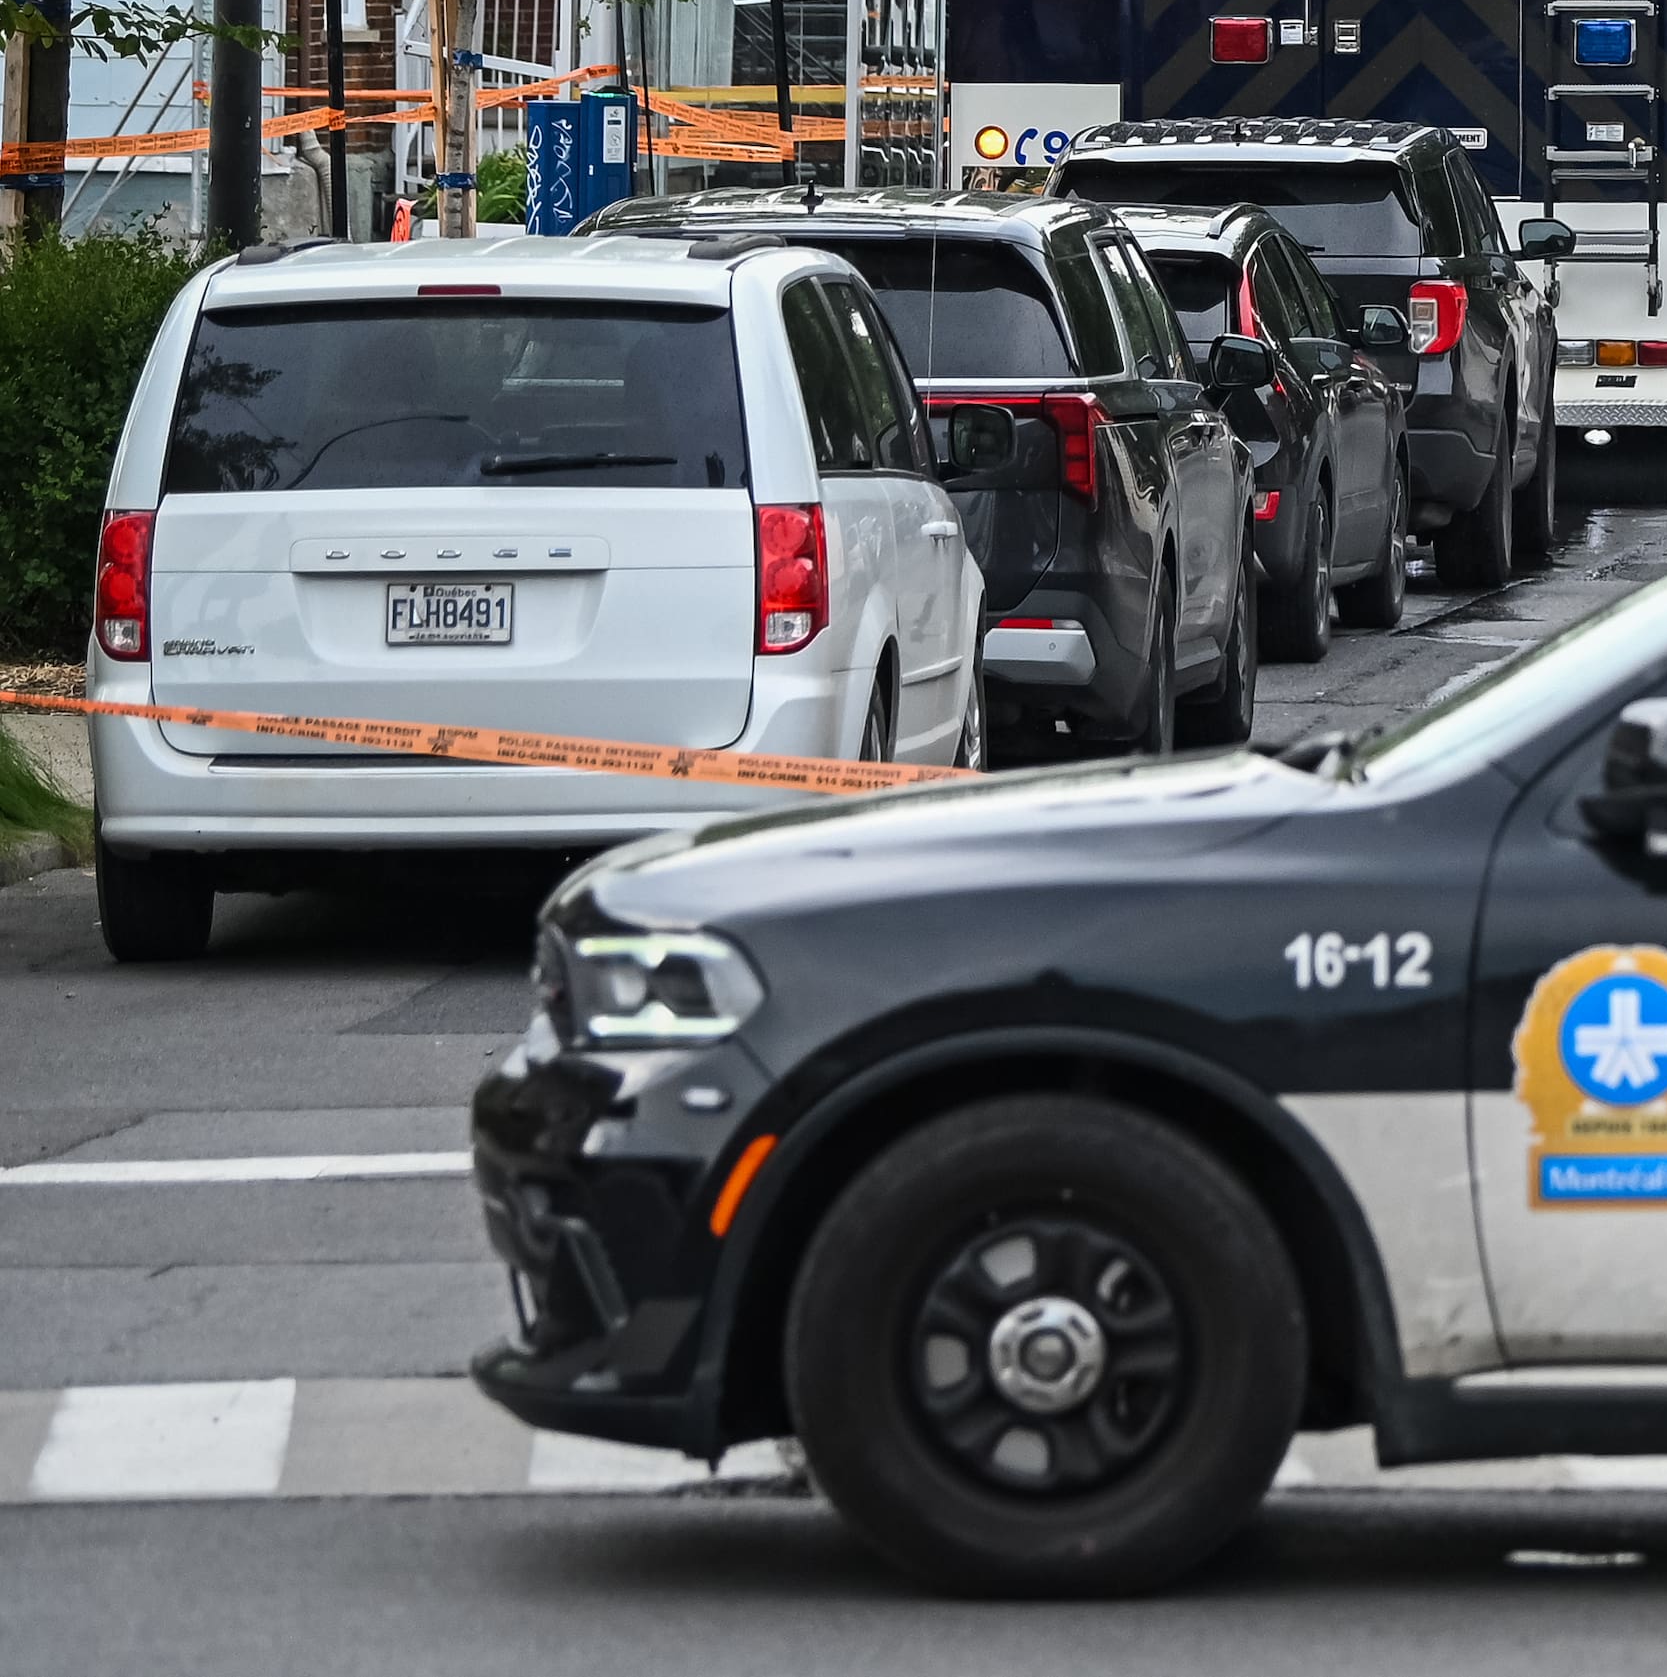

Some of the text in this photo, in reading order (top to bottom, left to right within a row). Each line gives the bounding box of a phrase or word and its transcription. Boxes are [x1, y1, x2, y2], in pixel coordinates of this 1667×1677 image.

[435, 586, 478, 597] Québec
[391, 597, 506, 630] FLH8491
[304, 717, 361, 732] PASSAGE
[364, 724, 422, 738] INTERDIT
[334, 733, 357, 744] 514
[498, 735, 662, 761] POLICE PASSAGE INTERDIT
[496, 748, 569, 764] INFO-CRIME
[575, 755, 598, 766] 514
[738, 757, 781, 770] POLICE
[815, 776, 838, 786] 514
[1284, 932, 1432, 989] 16-12
[1550, 1163, 1664, 1192] Montréal
